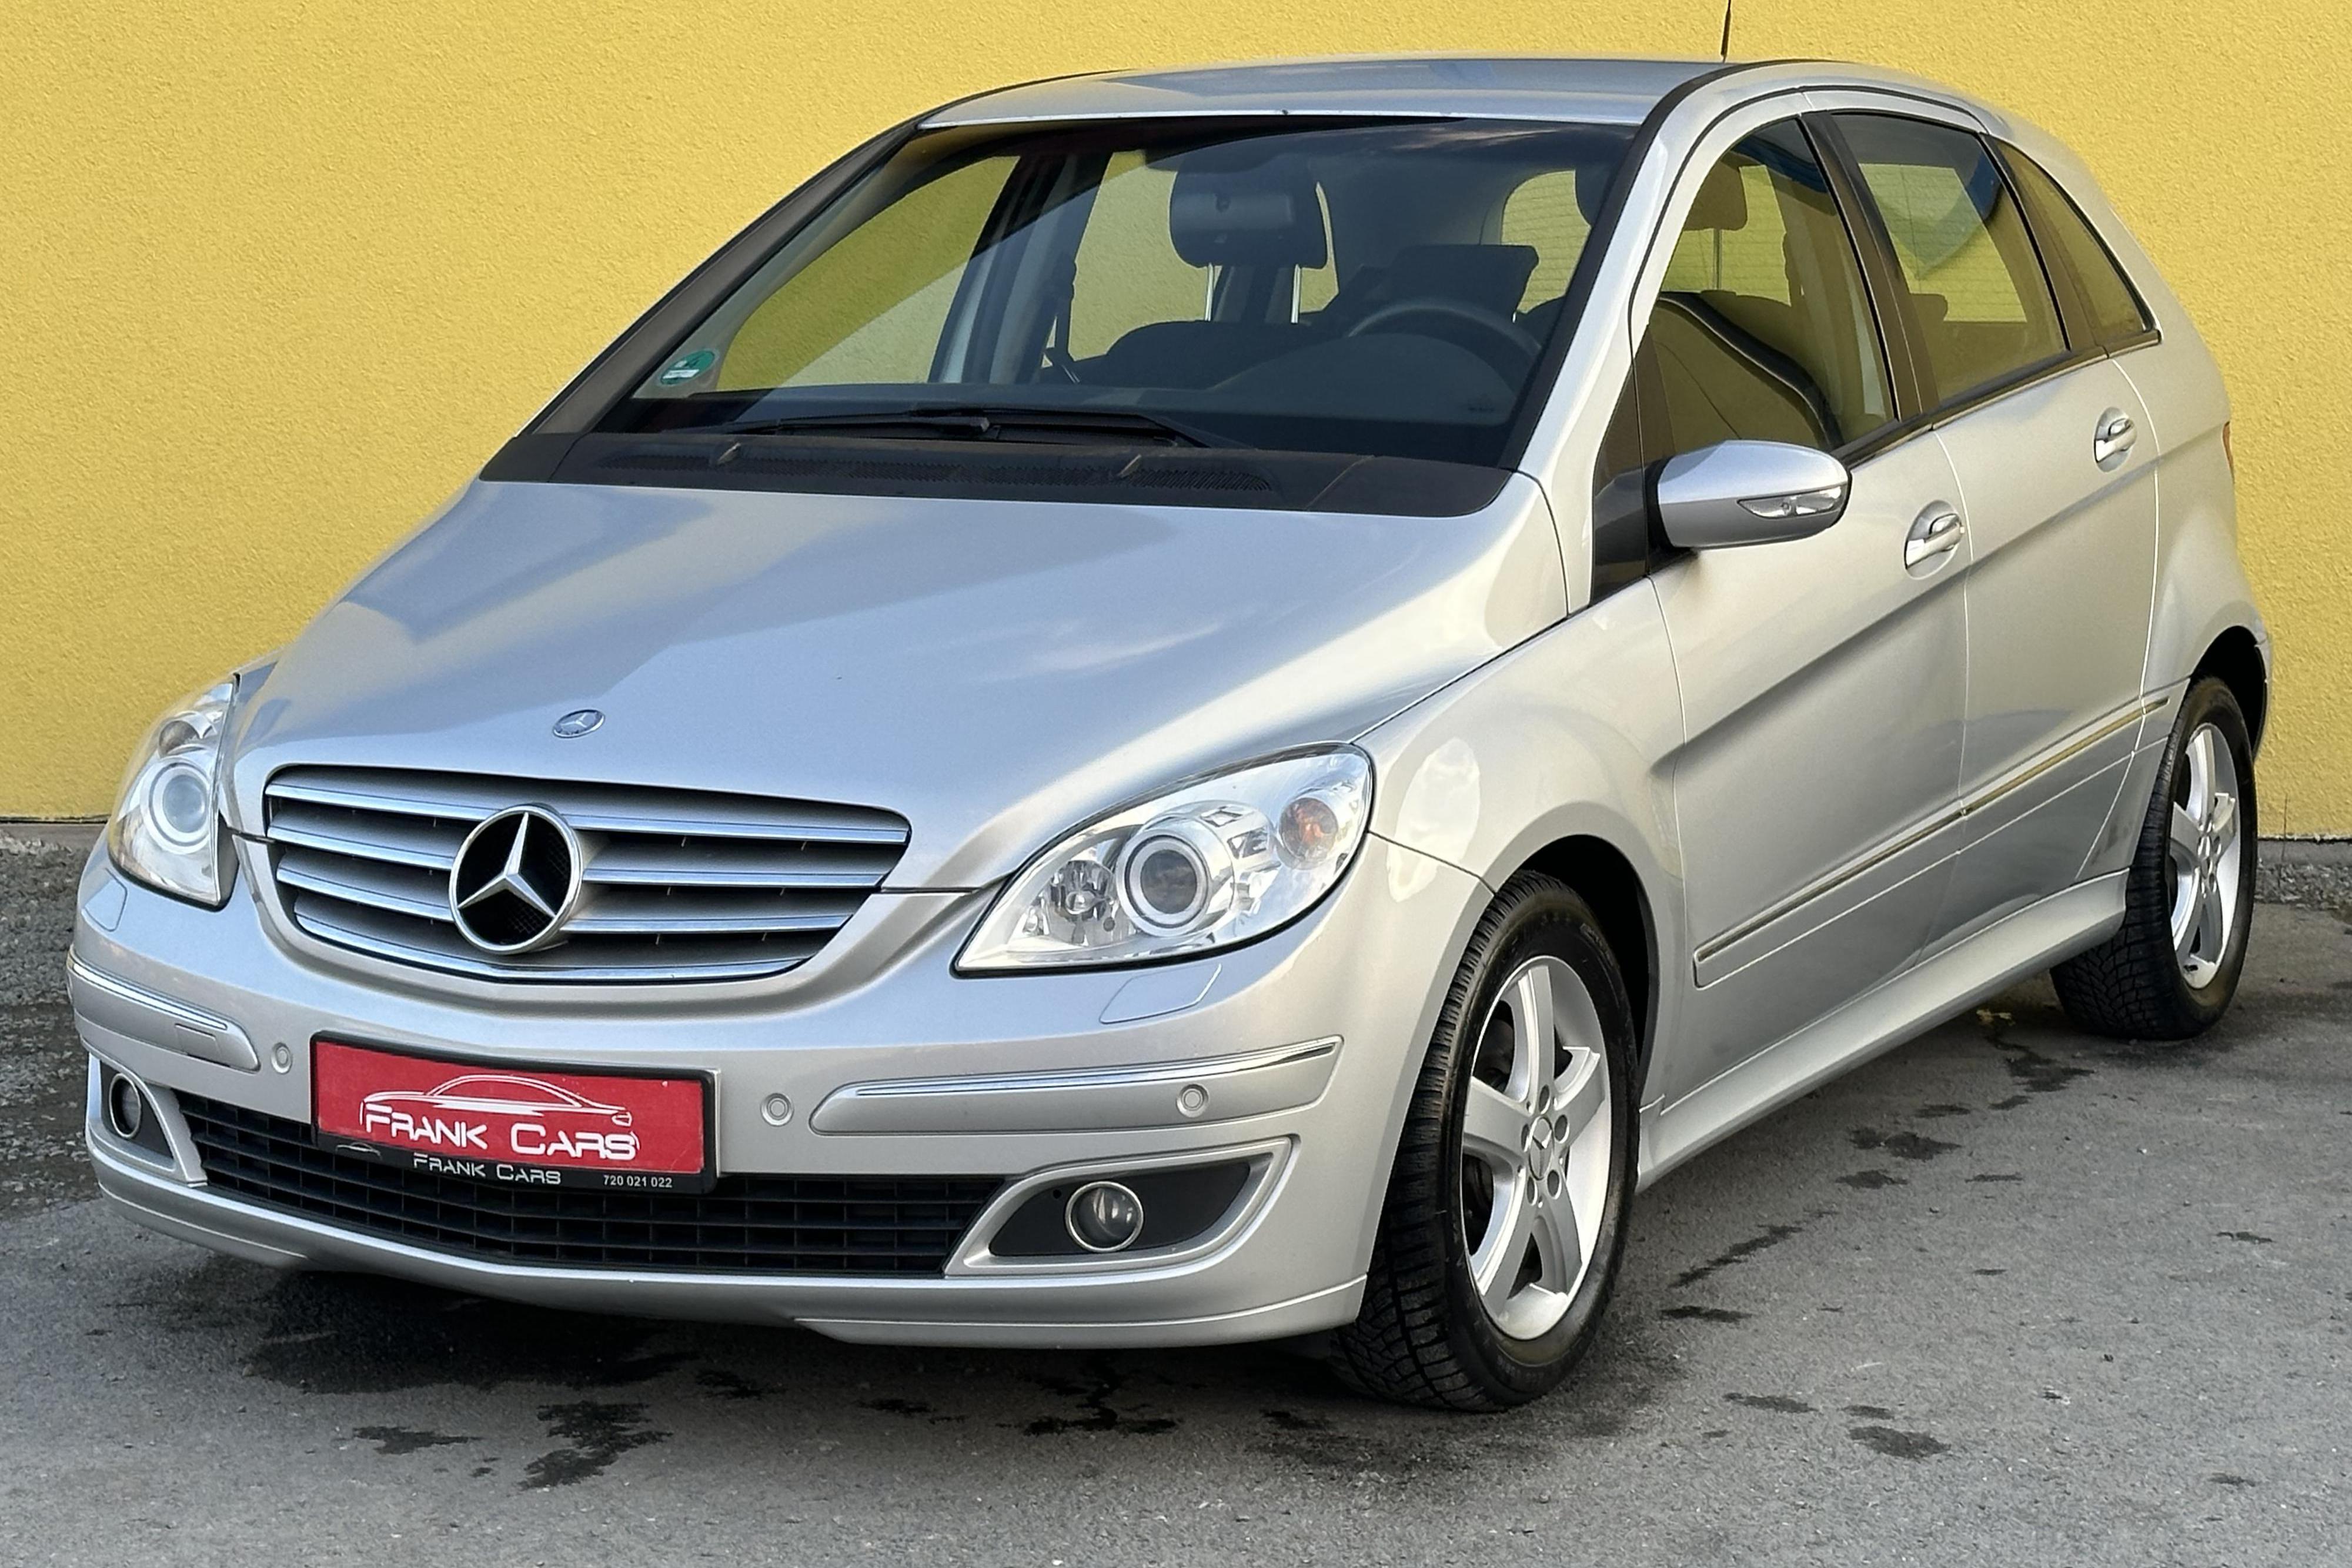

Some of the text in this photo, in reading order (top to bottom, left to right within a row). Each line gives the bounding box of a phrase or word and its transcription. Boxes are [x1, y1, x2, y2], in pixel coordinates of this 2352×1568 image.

[365, 1103, 636, 1161] FRANK CARS
[413, 1152, 562, 1184] FRANK CARS
[603, 1175, 673, 1188] 720 021 022
